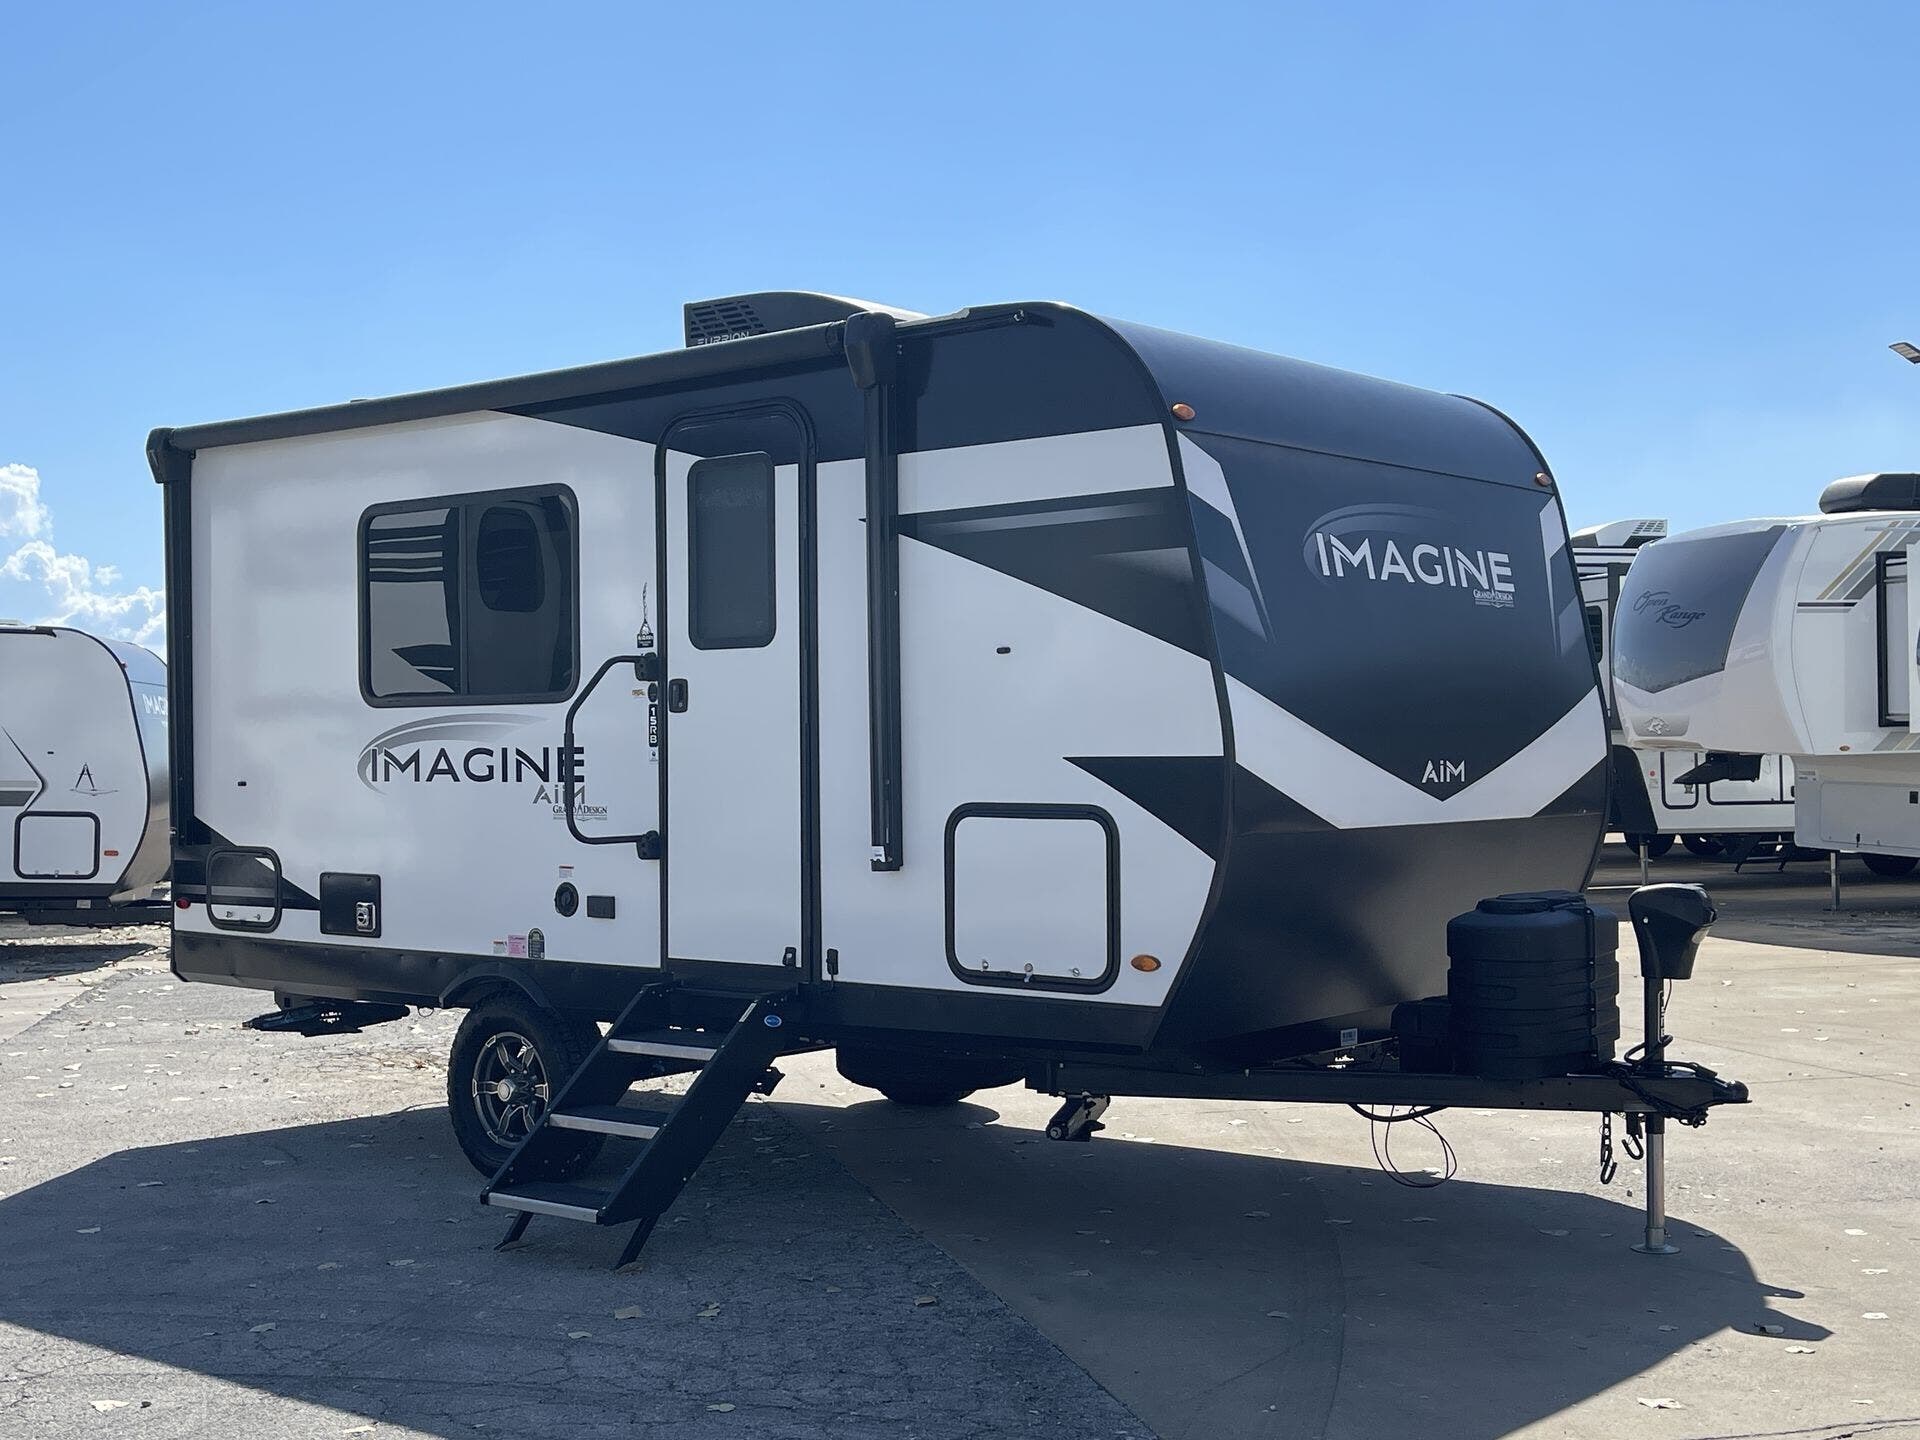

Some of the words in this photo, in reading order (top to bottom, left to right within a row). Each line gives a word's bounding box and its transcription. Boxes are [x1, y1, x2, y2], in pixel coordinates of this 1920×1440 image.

[1314, 532, 1516, 592] IMAGINE
[1633, 591, 1671, 615] Open
[1656, 604, 1706, 629] Range
[371, 747, 585, 783] IMAGINE
